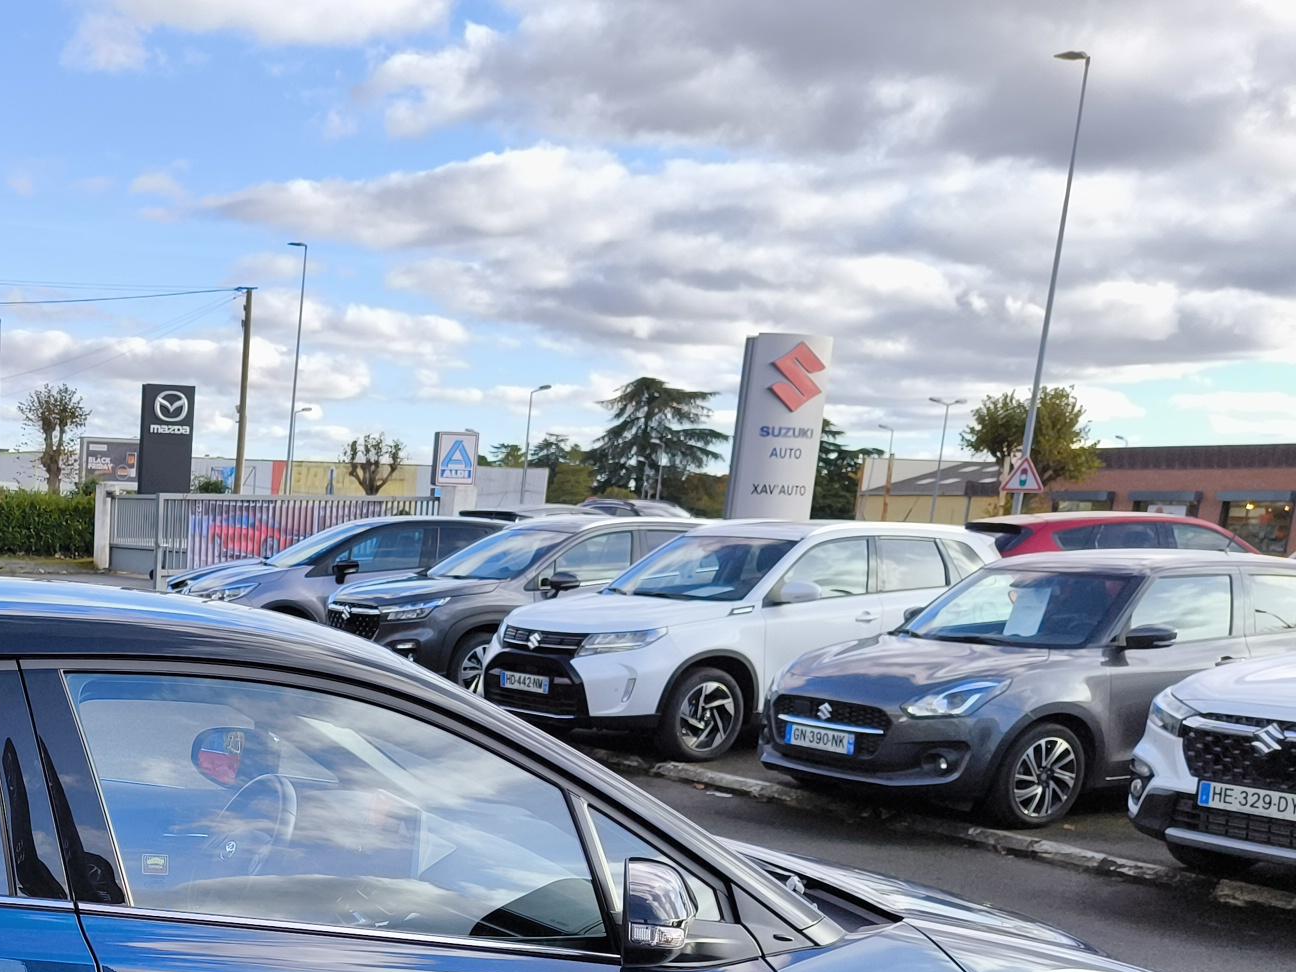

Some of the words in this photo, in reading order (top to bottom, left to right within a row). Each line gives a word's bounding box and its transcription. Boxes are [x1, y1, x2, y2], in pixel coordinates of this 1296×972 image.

[759, 425, 814, 439] SUZUKI
[88, 456, 112, 464] BLACK
[769, 447, 802, 460] AUTO
[443, 469, 468, 479] ALDI
[751, 483, 806, 496] XAV'AUTO
